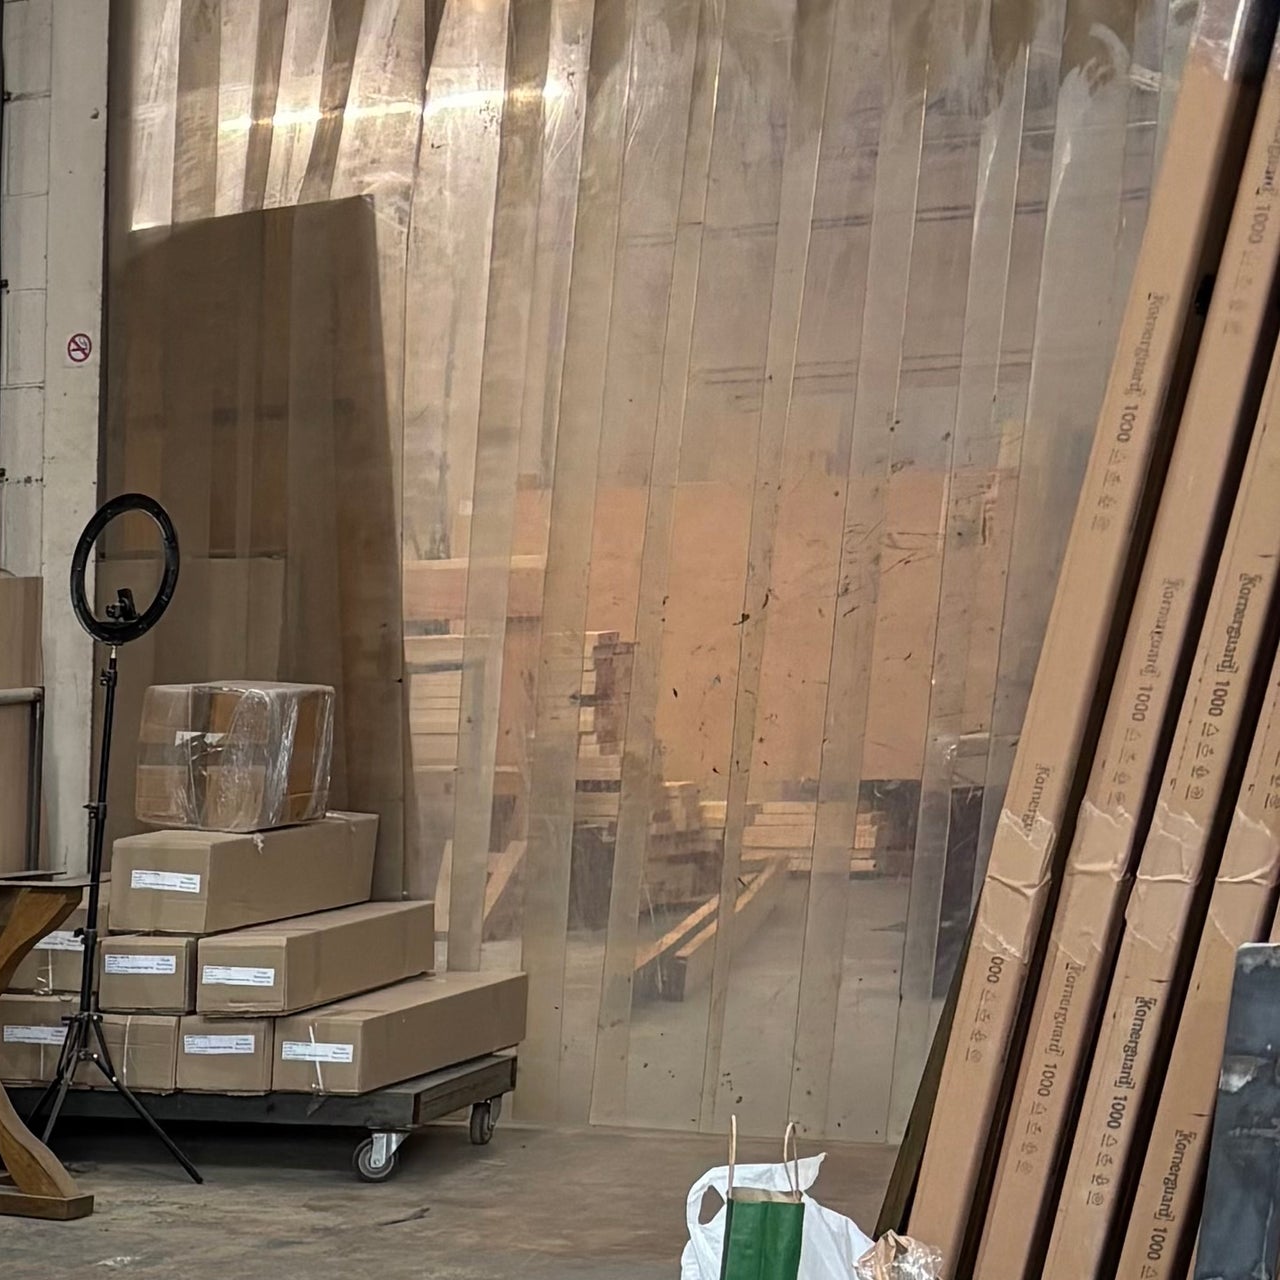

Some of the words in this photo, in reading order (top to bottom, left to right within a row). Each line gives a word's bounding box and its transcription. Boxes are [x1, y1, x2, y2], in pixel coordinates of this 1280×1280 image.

[1116, 404, 1139, 443] 1000
[1216, 573, 1262, 674] Kornerguard
[1131, 684, 1152, 723] 1000
[1208, 679, 1231, 719] 1000
[987, 956, 1005, 984] 000
[1045, 961, 1085, 1057] Kornerguard
[1114, 996, 1157, 1088] Kornerguard
[1038, 1061, 1058, 1098] 1000
[1107, 1092, 1129, 1130] 1000
[1153, 1127, 1197, 1222] Kornerguard
[1145, 1225, 1168, 1261] 1000
